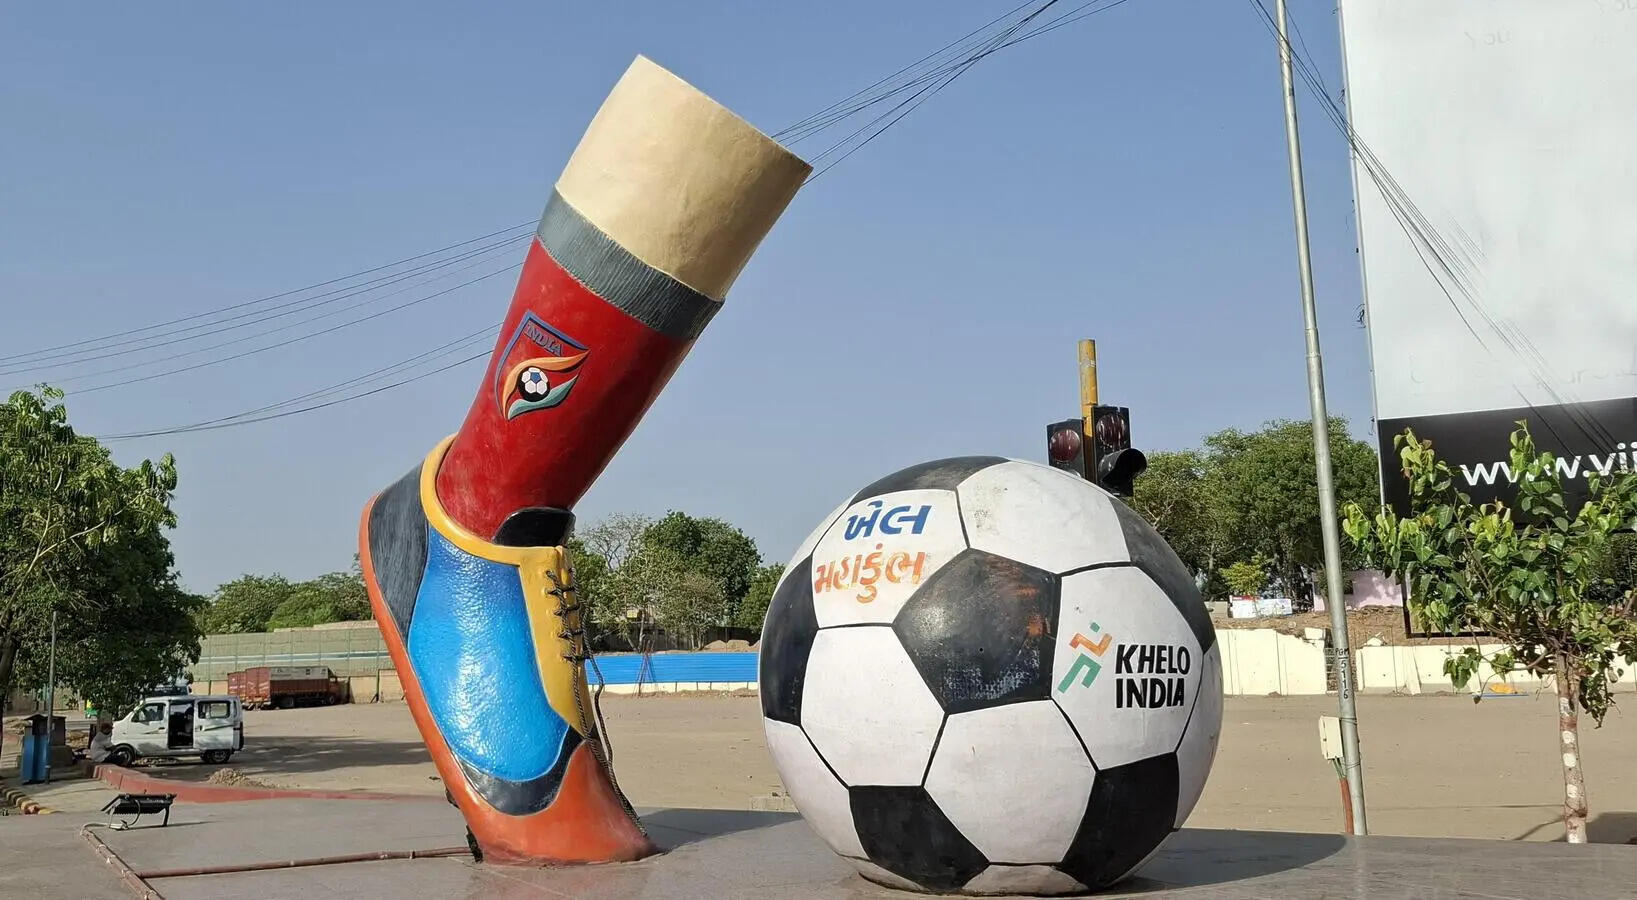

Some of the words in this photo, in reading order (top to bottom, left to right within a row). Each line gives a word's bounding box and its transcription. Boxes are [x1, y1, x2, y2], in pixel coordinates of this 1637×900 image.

[524, 321, 563, 356] INDIA
[844, 500, 932, 540] ખેલ
[814, 543, 926, 603] મહાકુંભ
[1115, 644, 1191, 675] KHELO
[1116, 678, 1185, 709] INDIA
